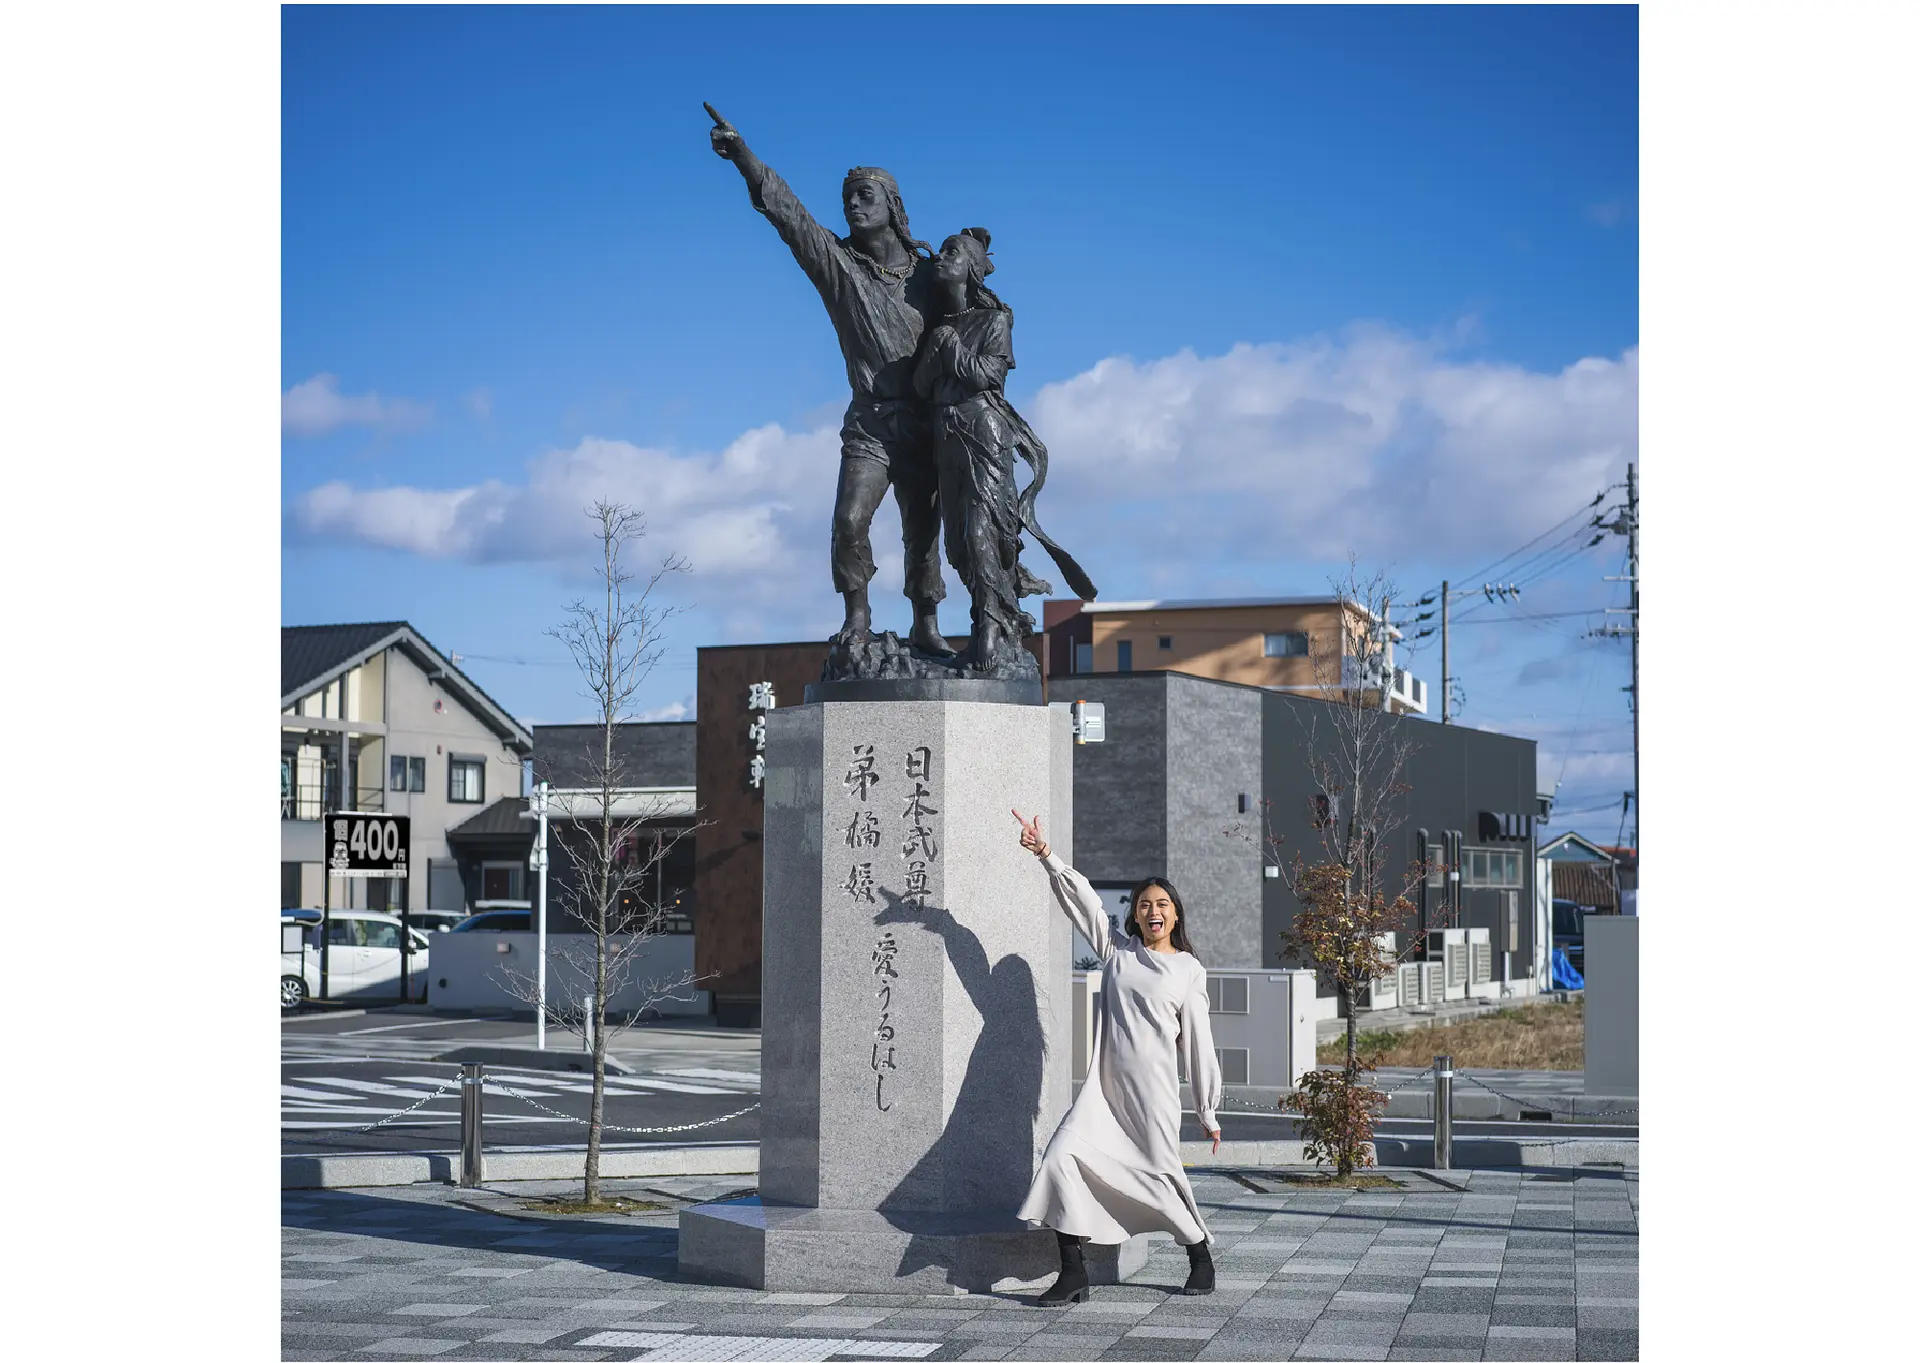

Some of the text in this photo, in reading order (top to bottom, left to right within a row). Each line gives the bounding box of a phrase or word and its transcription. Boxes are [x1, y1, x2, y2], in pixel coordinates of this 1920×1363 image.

[902, 746, 938, 911] 日本武尊
[871, 932, 899, 1112] 愛うるはし
